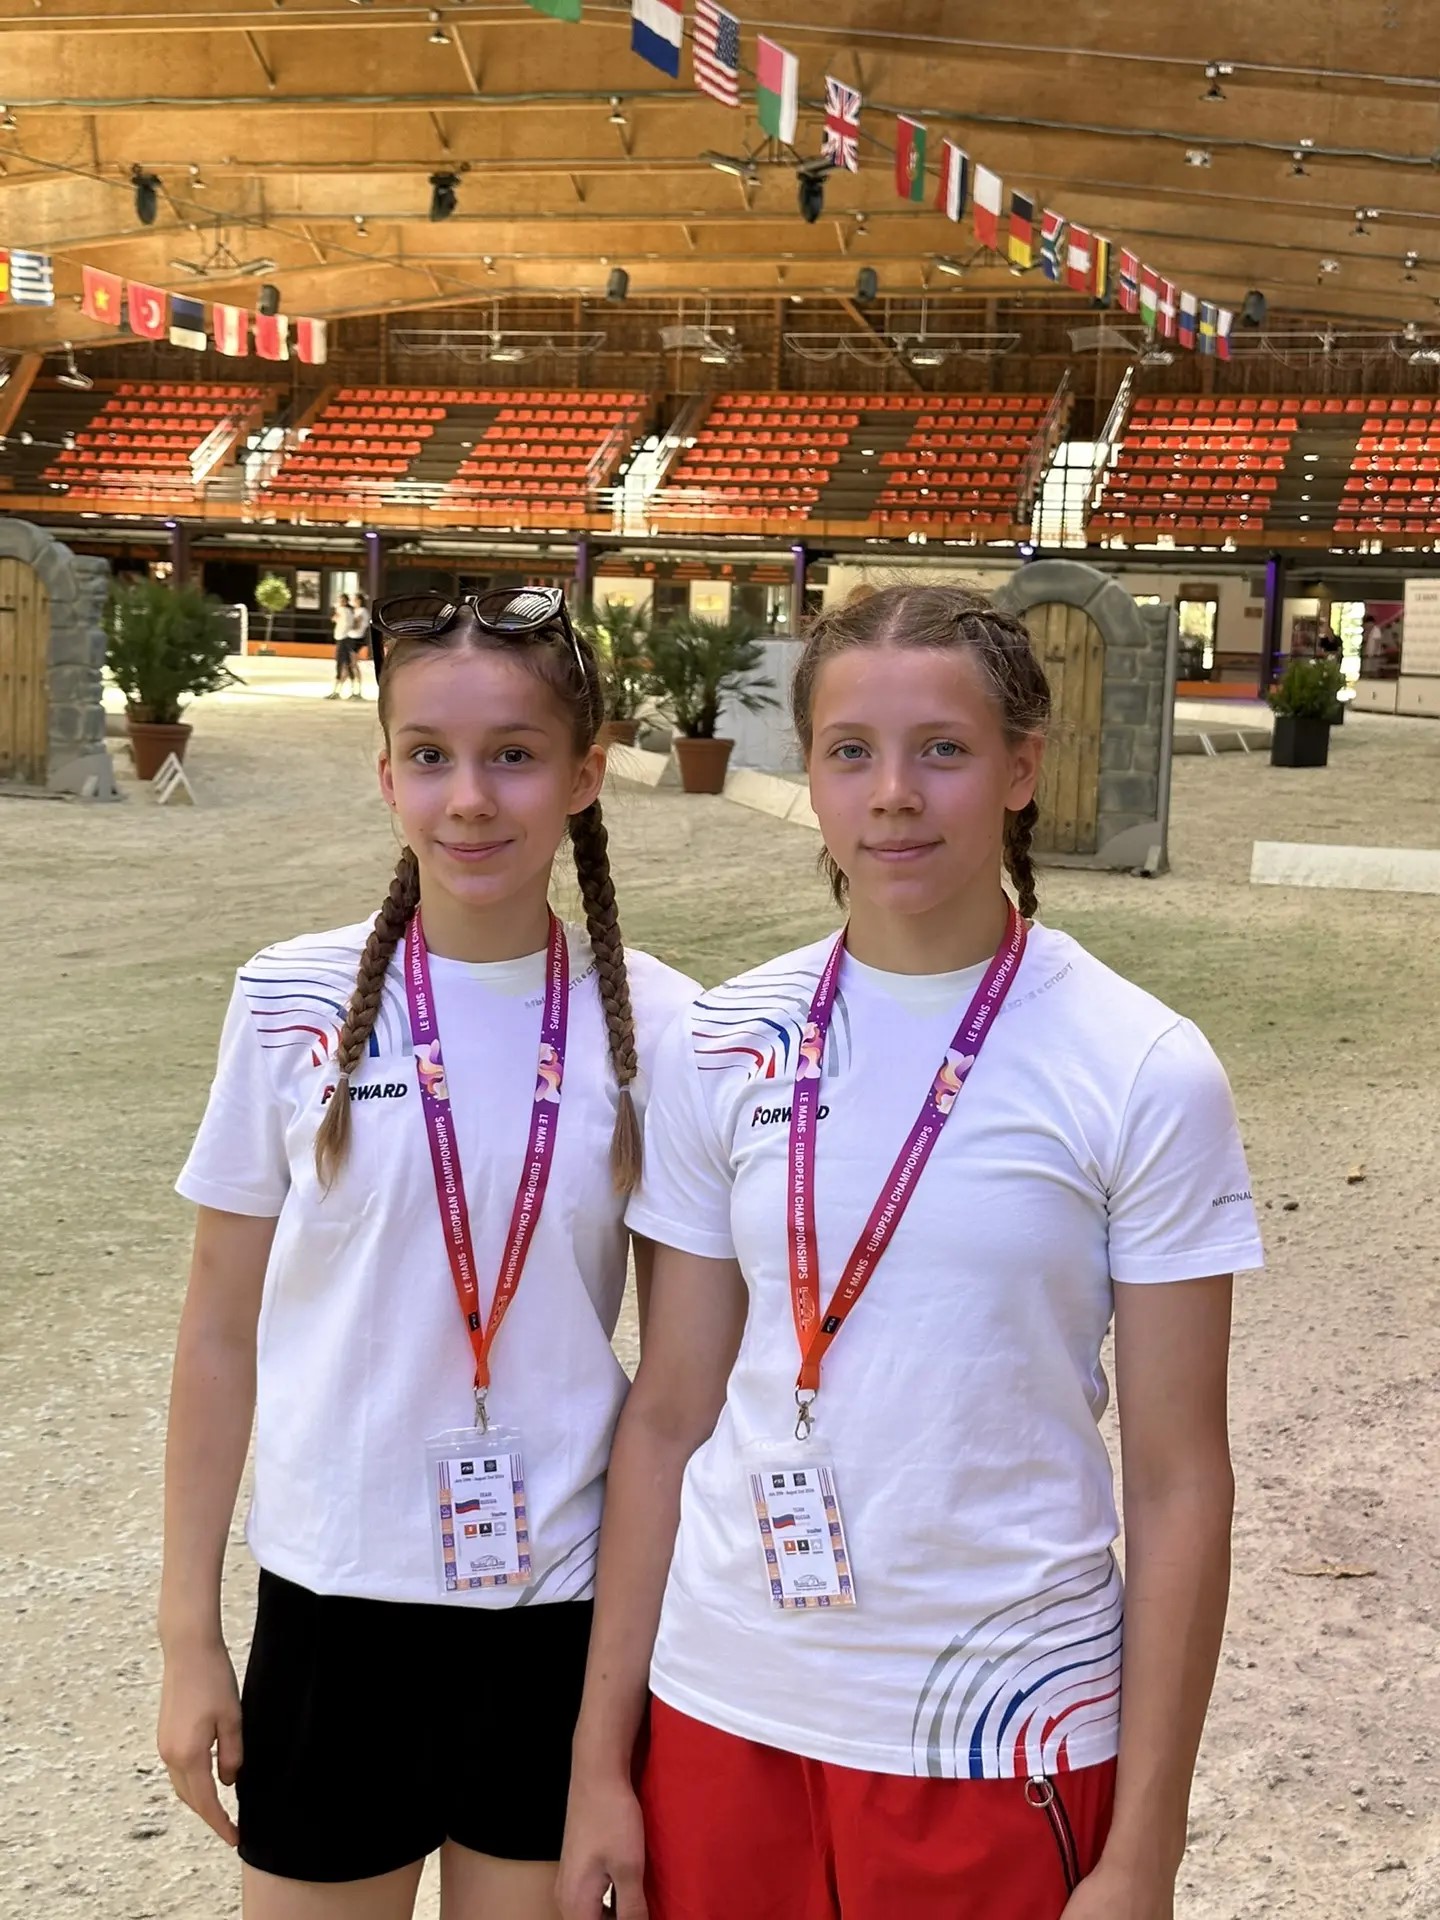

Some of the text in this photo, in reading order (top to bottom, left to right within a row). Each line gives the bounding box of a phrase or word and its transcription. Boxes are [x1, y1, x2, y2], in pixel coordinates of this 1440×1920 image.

[987, 952, 1016, 999] EUROPEAN
[415, 992, 429, 1019] MANS
[550, 960, 562, 1030] CHAMPIONSHIPS
[420, 1020, 430, 1032] LE
[971, 1004, 991, 1030] MANS
[965, 1030, 979, 1043] LE
[321, 1083, 408, 1105] FRWARD
[799, 1092, 809, 1103] LE
[539, 1113, 548, 1125] LE
[751, 1105, 830, 1127] FORWD
[796, 1105, 808, 1133] MANS
[434, 1115, 456, 1193] CHAMPIONSHIPS
[534, 1126, 547, 1154] MANS
[794, 1142, 805, 1193] EUROPEAN
[523, 1162, 541, 1213] EUROPEAN
[1212, 1190, 1252, 1207] NATIONAL
[447, 1194, 465, 1246] EUROPEAN
[843, 1287, 855, 1299] LE
[850, 1259, 869, 1287] MANS
[867, 1202, 897, 1253] EUROPEAN
[890, 1125, 933, 1202] CHAMPIONSHIPS
[503, 1213, 530, 1289] CHAMPIONSHIPS
[794, 1196, 809, 1280] CHAMPIONSHIPS
[457, 1252, 472, 1280] MANS
[464, 1281, 474, 1294] LE
